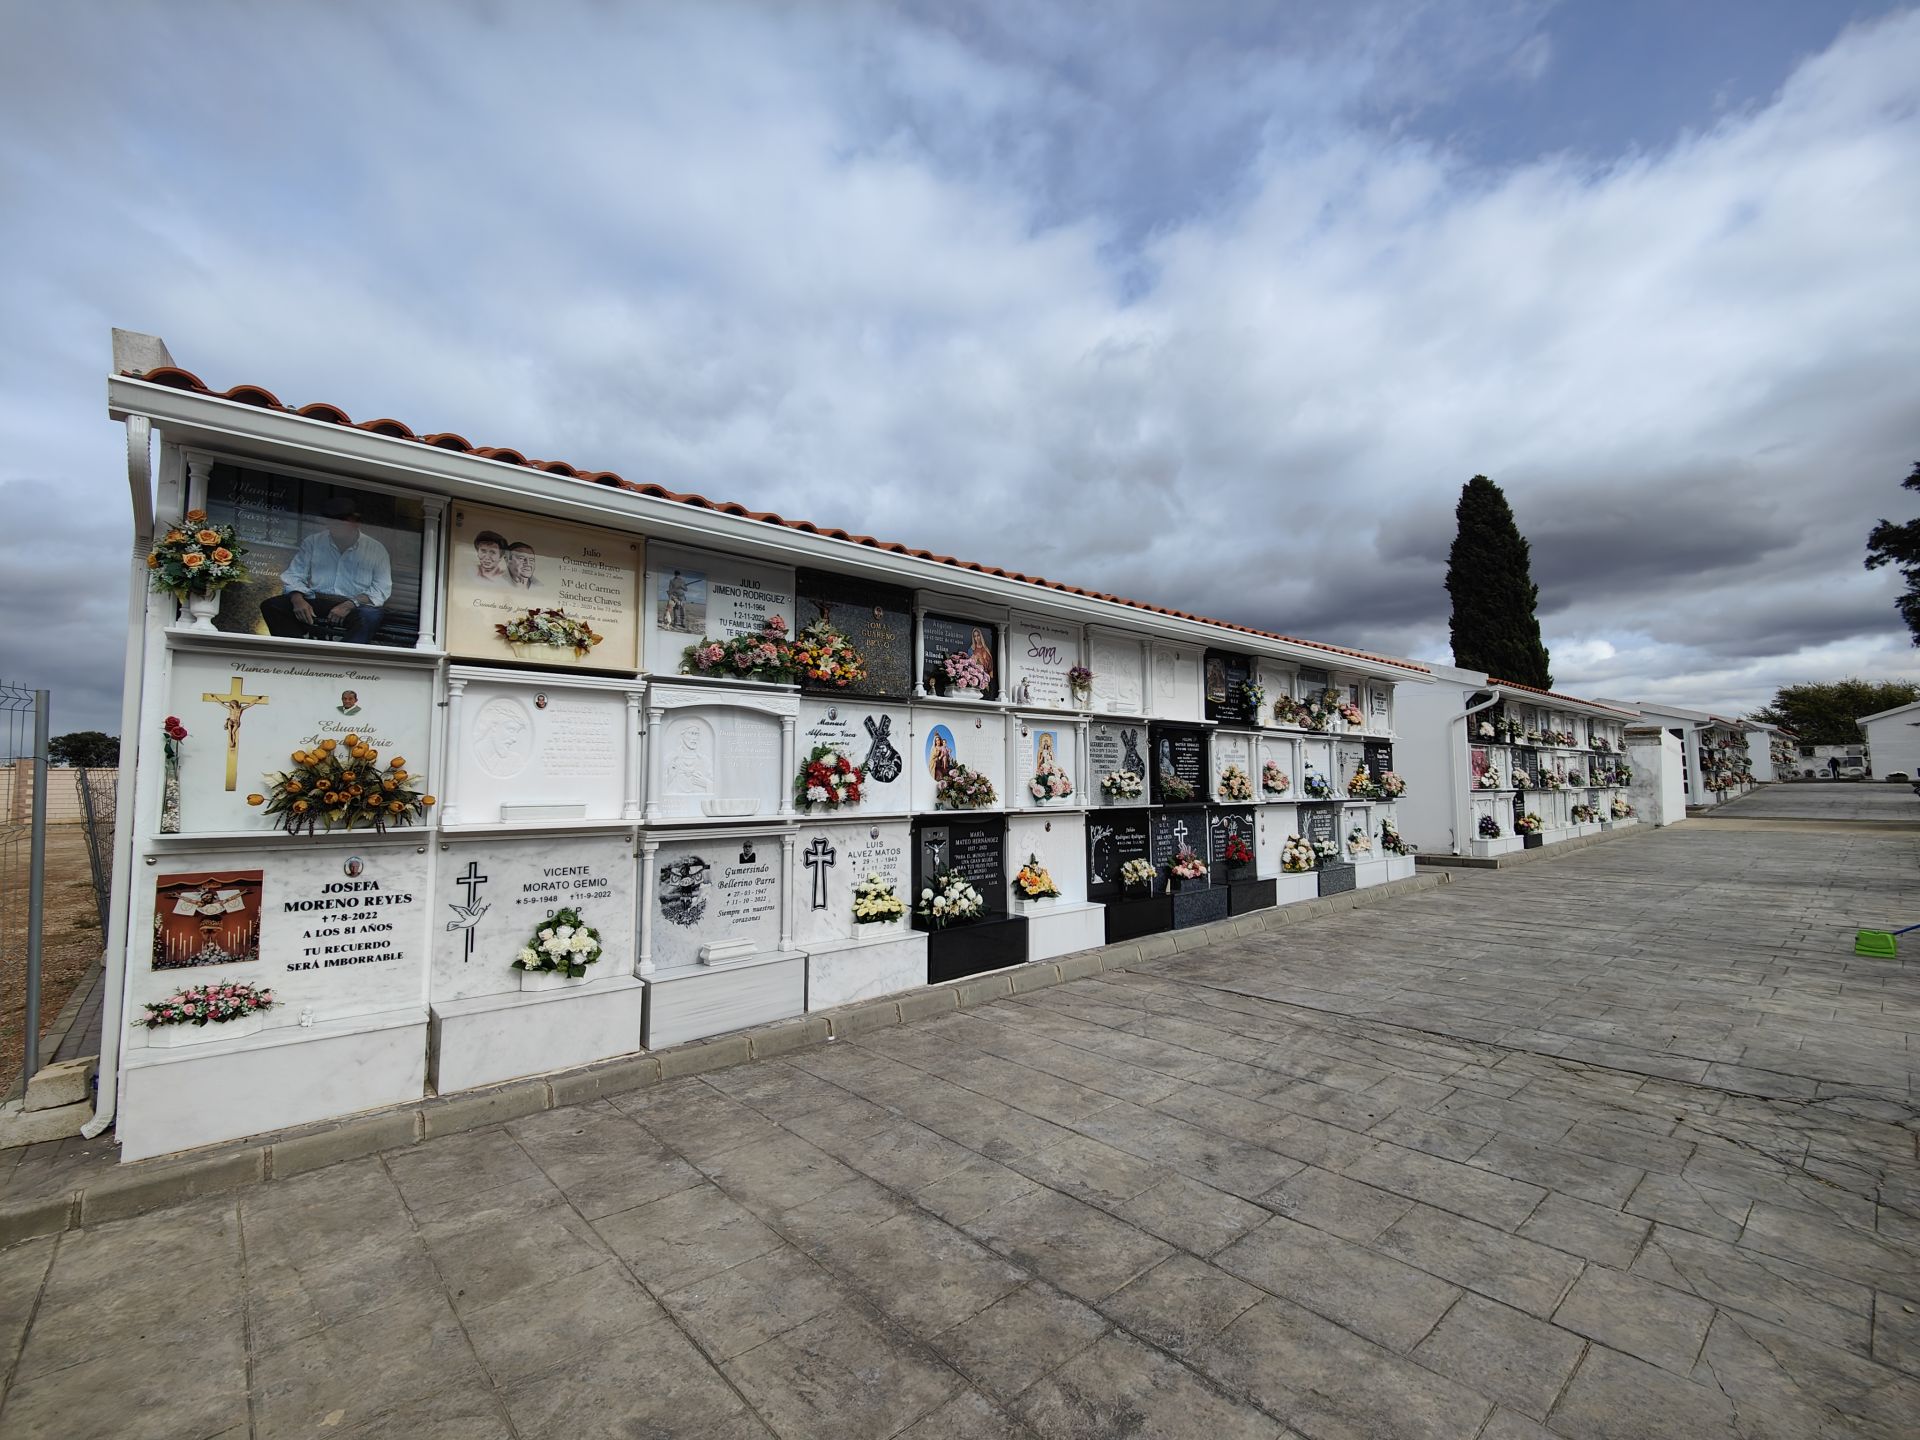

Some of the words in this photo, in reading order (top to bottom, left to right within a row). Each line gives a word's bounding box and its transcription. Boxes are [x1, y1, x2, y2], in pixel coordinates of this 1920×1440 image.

[583, 547, 602, 558] Julio
[575, 581, 588, 590] del
[589, 583, 621, 595] Carmen
[713, 585, 741, 597] JIMENO
[740, 579, 760, 590] JULIO
[559, 590, 593, 603] Sánchez
[594, 595, 622, 607] Chaves
[720, 618, 728, 627] TU
[728, 620, 752, 630] FAMILIA
[726, 628, 734, 637] TE
[1027, 632, 1063, 665] Sara
[230, 662, 271, 674] Nunca
[272, 666, 283, 675] te
[284, 666, 345, 679] olvidaremos
[318, 720, 377, 733] Eduardo
[817, 718, 847, 727] Manuel
[866, 841, 884, 849] LUIS
[875, 848, 901, 856] MATOS
[543, 865, 590, 877] VICENTE
[725, 863, 769, 878] Gumersindo
[321, 880, 380, 894] JOSEFA
[523, 881, 570, 892] MORATO
[573, 877, 608, 889] GEMIO
[755, 877, 776, 886] Parra
[283, 897, 359, 913] MORENO
[364, 893, 413, 907] REYES
[523, 895, 558, 905] 5-9-1948
[575, 890, 612, 900] 11-9-2022
[331, 911, 378, 923] 7-8-2022
[303, 930, 311, 939] A
[315, 927, 340, 938] LOS
[344, 926, 356, 935] 81
[359, 922, 393, 933] AÑOS
[303, 947, 322, 956] TU
[325, 940, 391, 954] RECUERDO
[286, 959, 320, 972] SERÁ
[324, 951, 404, 968] IMBORRABLE
